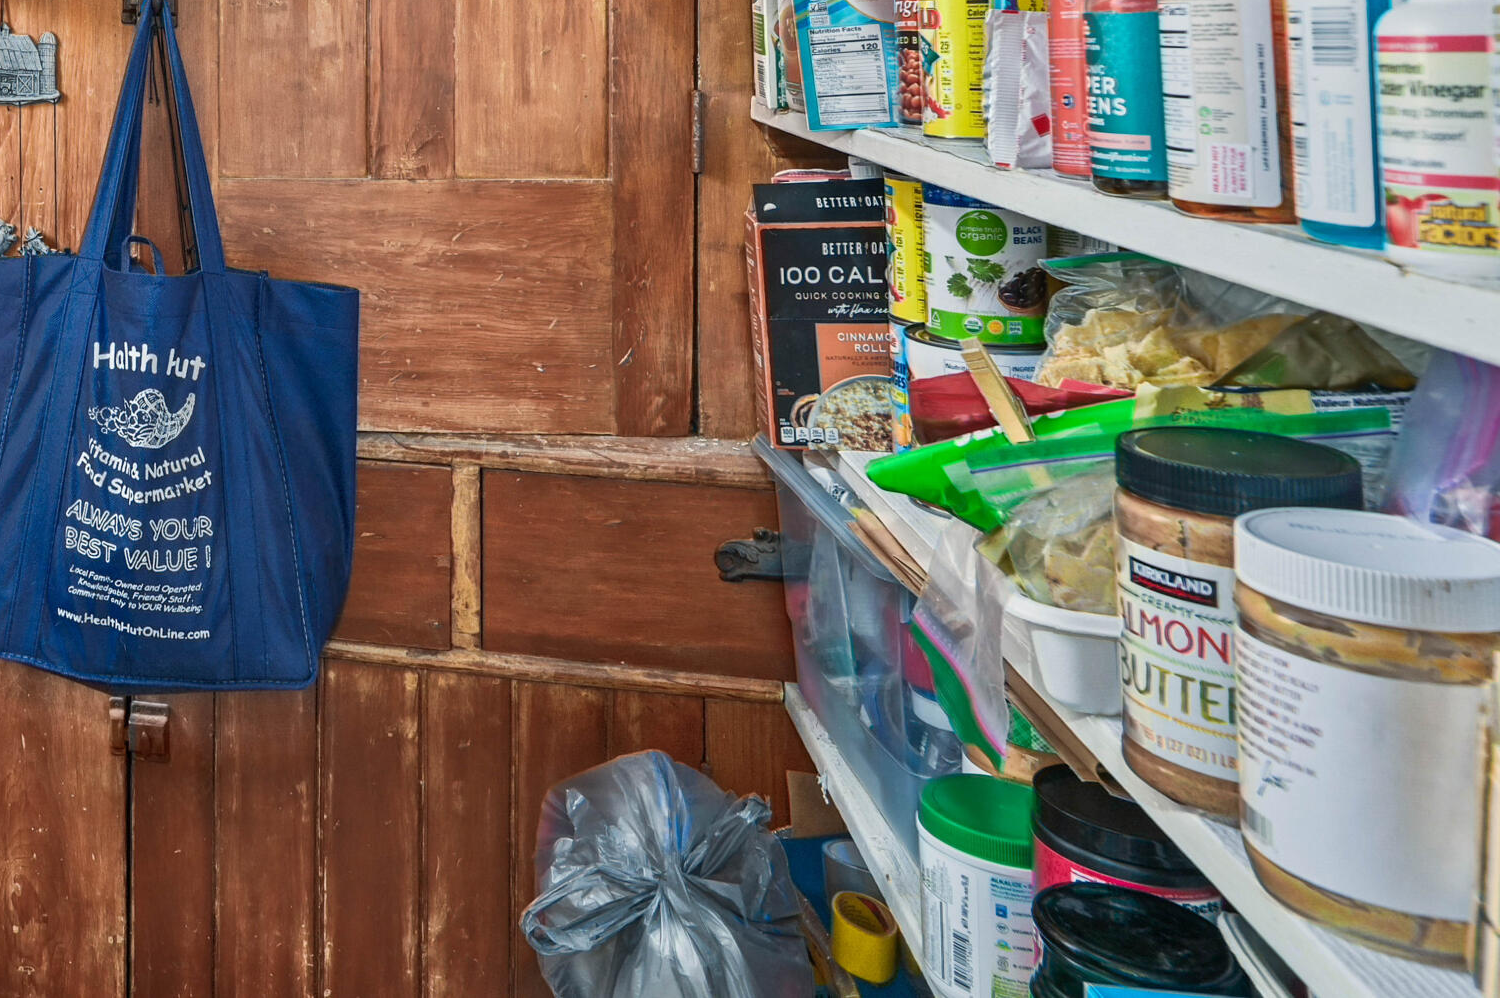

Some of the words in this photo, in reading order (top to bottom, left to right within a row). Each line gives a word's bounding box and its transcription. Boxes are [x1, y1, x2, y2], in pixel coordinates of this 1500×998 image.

[810, 27, 841, 35] Nutrition
[816, 197, 857, 208] BETTER
[959, 231, 1003, 242] organic
[1013, 235, 1042, 245] BEANS
[1013, 226, 1042, 235] BLACK
[822, 243, 862, 255] BETTER
[780, 266, 821, 285] 100
[832, 292, 880, 300] COOKING
[827, 304, 850, 318] with
[849, 303, 873, 318] flax
[854, 344, 887, 353] ROLL
[93, 341, 158, 374] Halth
[144, 446, 206, 481] Natural
[108, 469, 212, 505] Supermarket
[66, 499, 143, 541] ALWAYS
[150, 515, 214, 542] YOUR
[65, 525, 117, 564] BEST
[123, 547, 198, 572] VALUE
[114, 579, 143, 592] Owned
[144, 583, 161, 592] and
[1132, 560, 1213, 597] KIRKLAND
[110, 597, 127, 609] only
[128, 600, 137, 610] to
[137, 602, 163, 612] YOUR
[132, 591, 168, 604] Friendly
[57, 607, 211, 640] www.HealthHutOnLine.com
